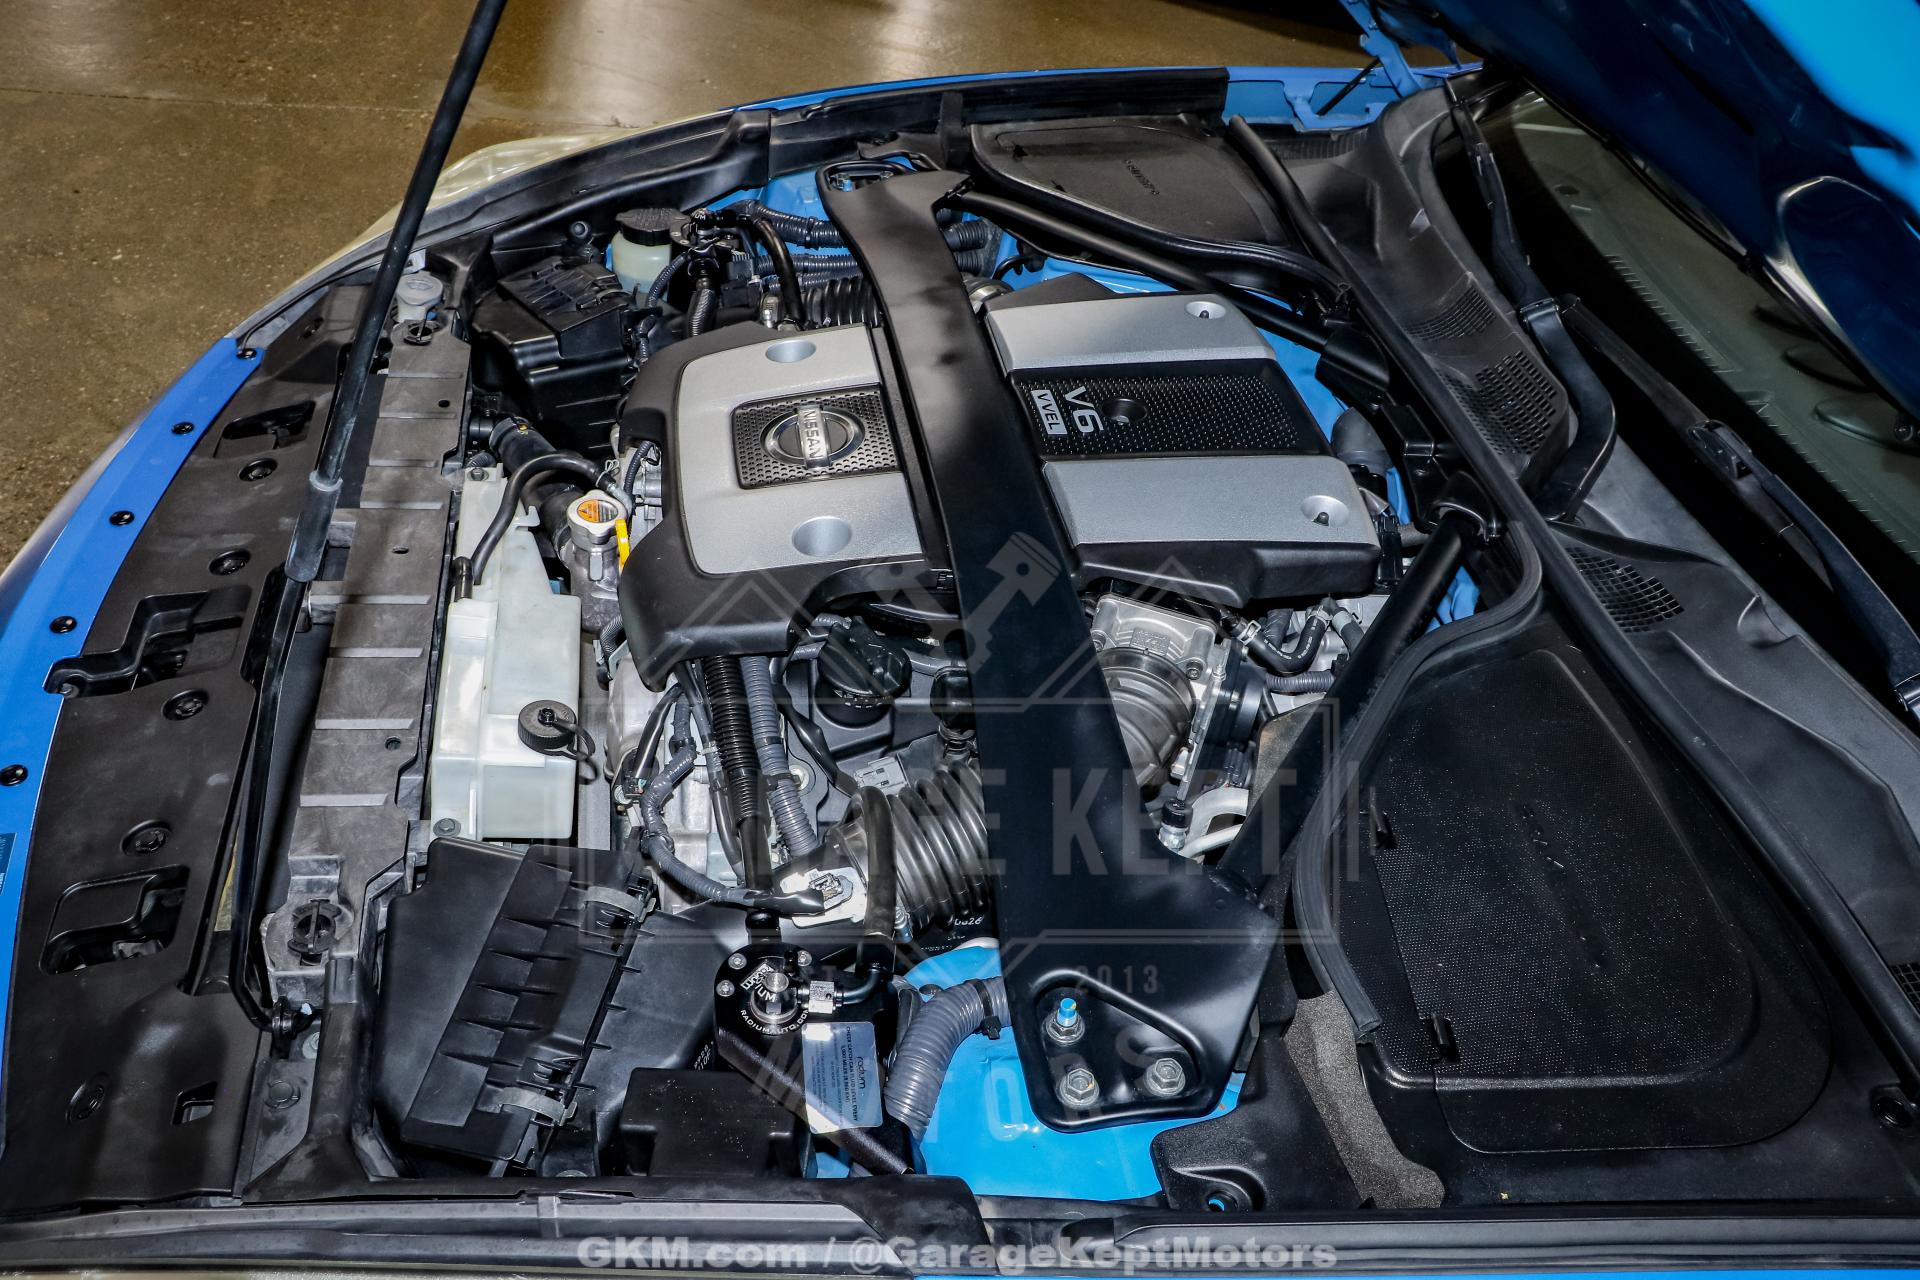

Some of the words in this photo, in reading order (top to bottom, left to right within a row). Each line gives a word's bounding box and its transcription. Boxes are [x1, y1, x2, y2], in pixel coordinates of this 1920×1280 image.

[1037, 392, 1061, 431] VVEL
[1064, 385, 1104, 433] V6
[803, 409, 825, 459] NISSAN
